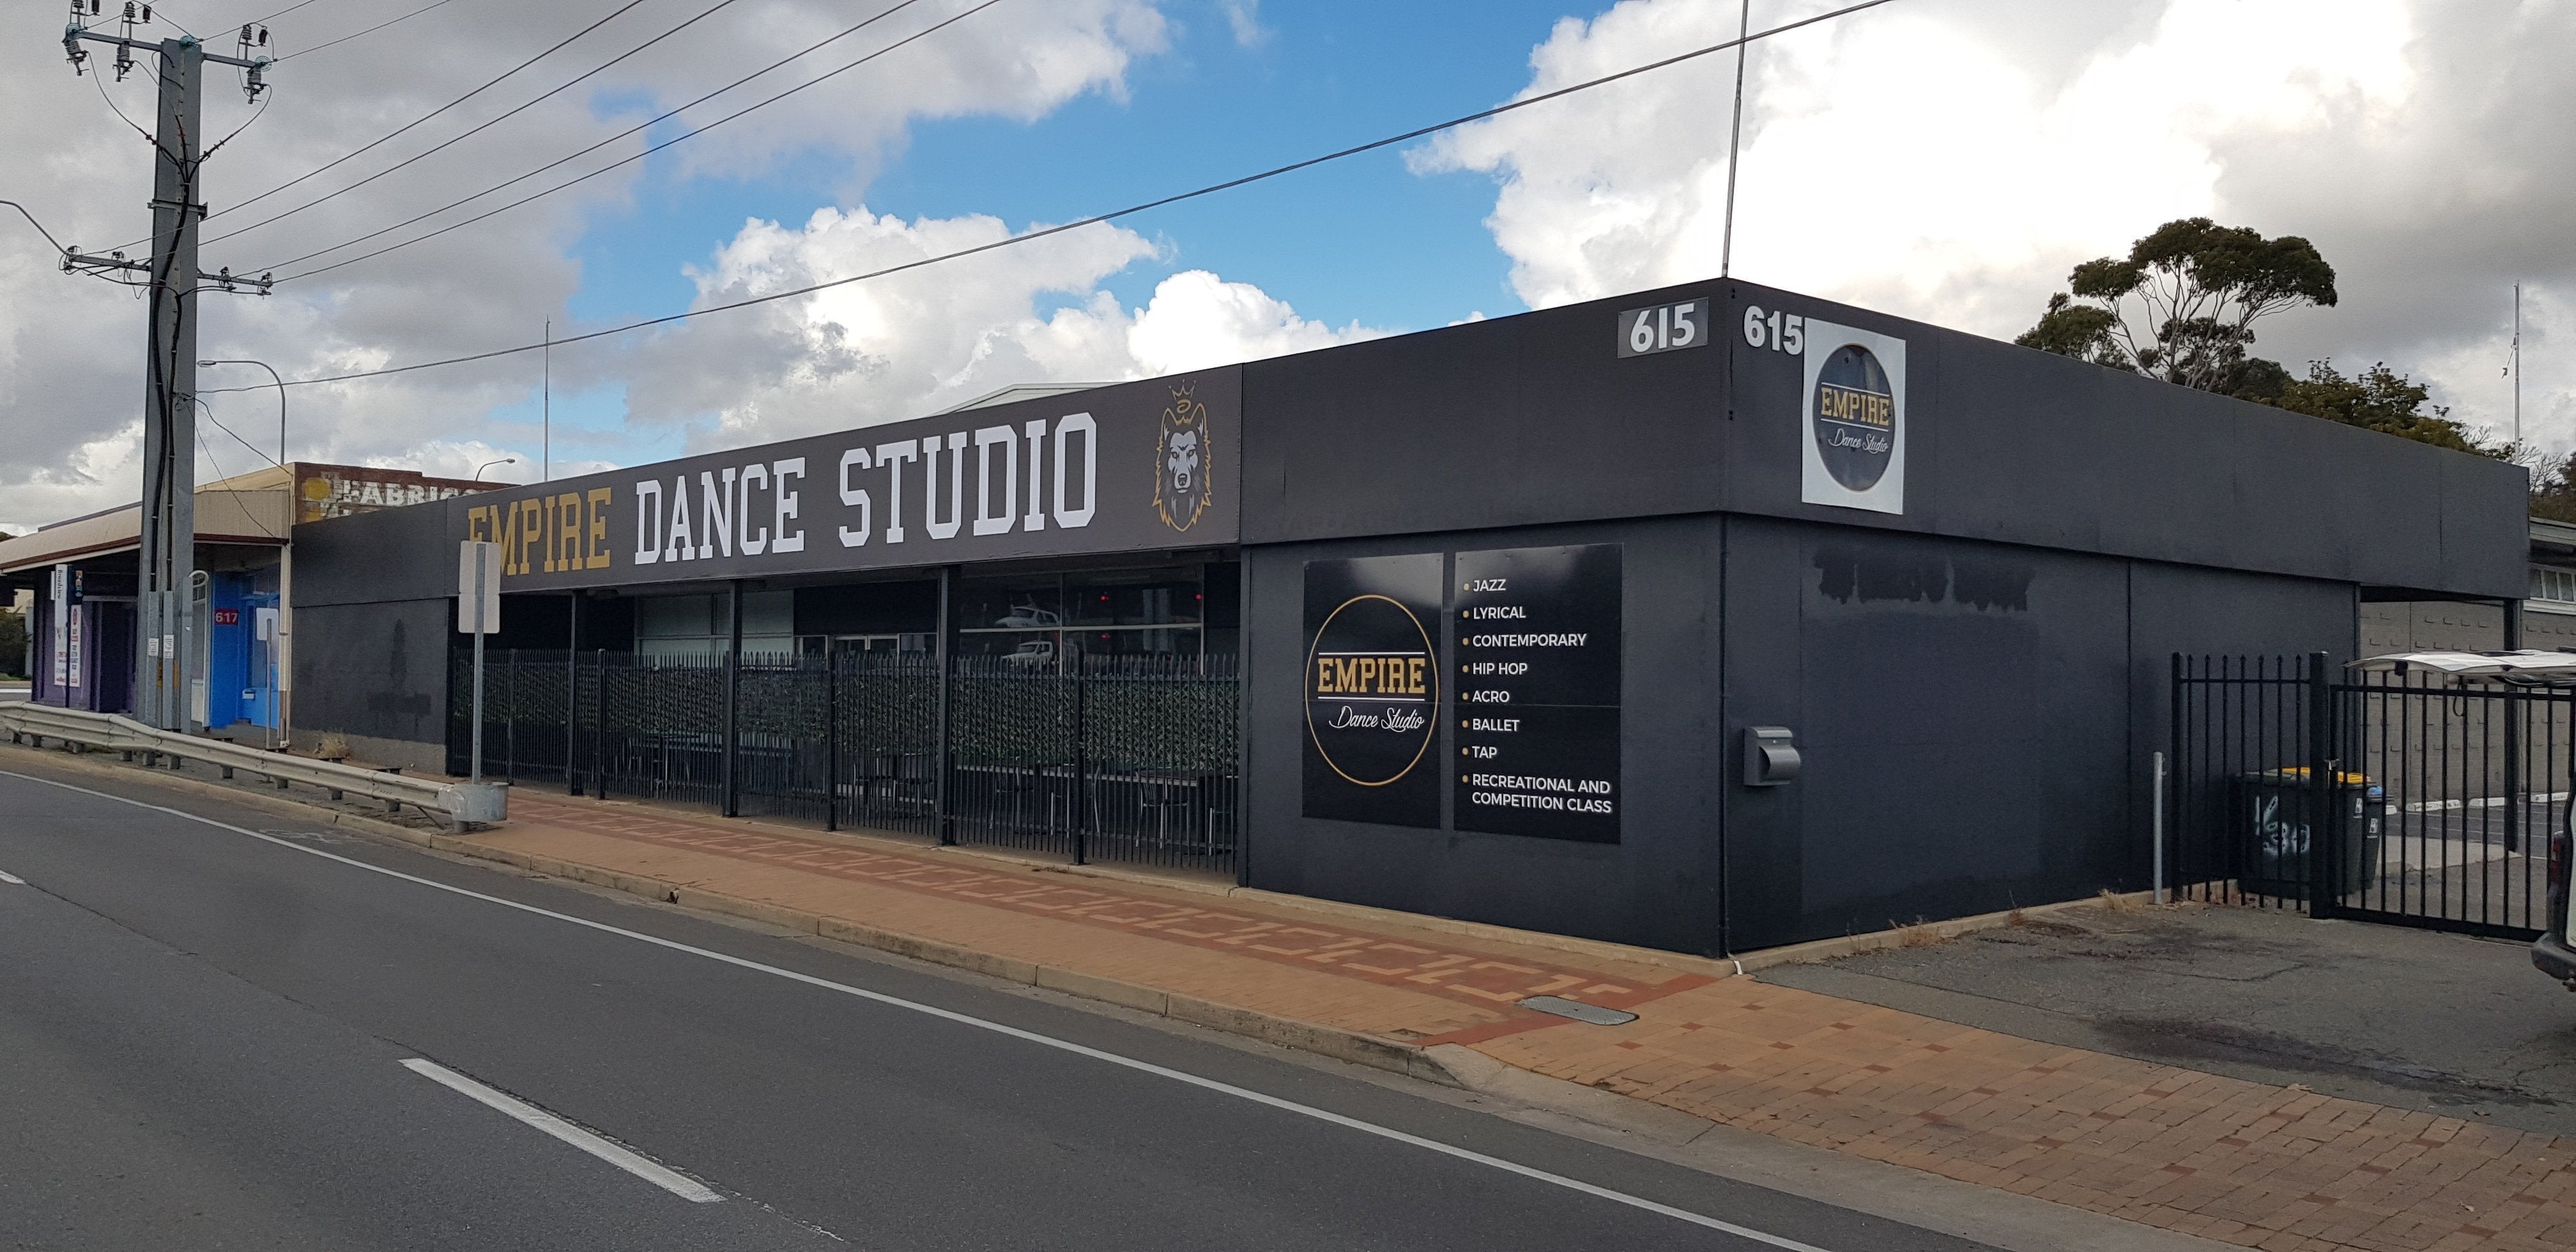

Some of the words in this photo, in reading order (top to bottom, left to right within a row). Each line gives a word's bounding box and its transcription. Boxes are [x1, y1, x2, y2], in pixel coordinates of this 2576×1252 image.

[1630, 302, 1696, 353] 615
[1744, 305, 1804, 355] 615
[1821, 387, 1889, 426] EMPIRE
[1828, 428, 1862, 448] Dance
[1862, 433, 1889, 454] Studio
[634, 457, 806, 565] DANCE
[839, 412, 1098, 548] STUDIO
[1473, 579, 1506, 592] JAZZ
[215, 612, 238, 623] 617
[1473, 606, 1526, 620] LYRICAL
[1473, 633, 1588, 647] CONTEMPORARY
[1318, 658, 1425, 694] EMPIRE
[1473, 662, 1495, 675] HIP
[1498, 662, 1528, 675] HOP
[1472, 690, 1510, 703] ACRO
[1328, 705, 1379, 729] Dance
[1381, 707, 1425, 733] Studio
[1473, 718, 1520, 732] BALLET
[1472, 745, 1498, 759] TAP
[1473, 774, 1575, 792] RECREATIONAL
[1577, 779, 1611, 794] AND
[1472, 791, 1563, 811] COMPETITION
[1567, 798, 1613, 814] CLASS
